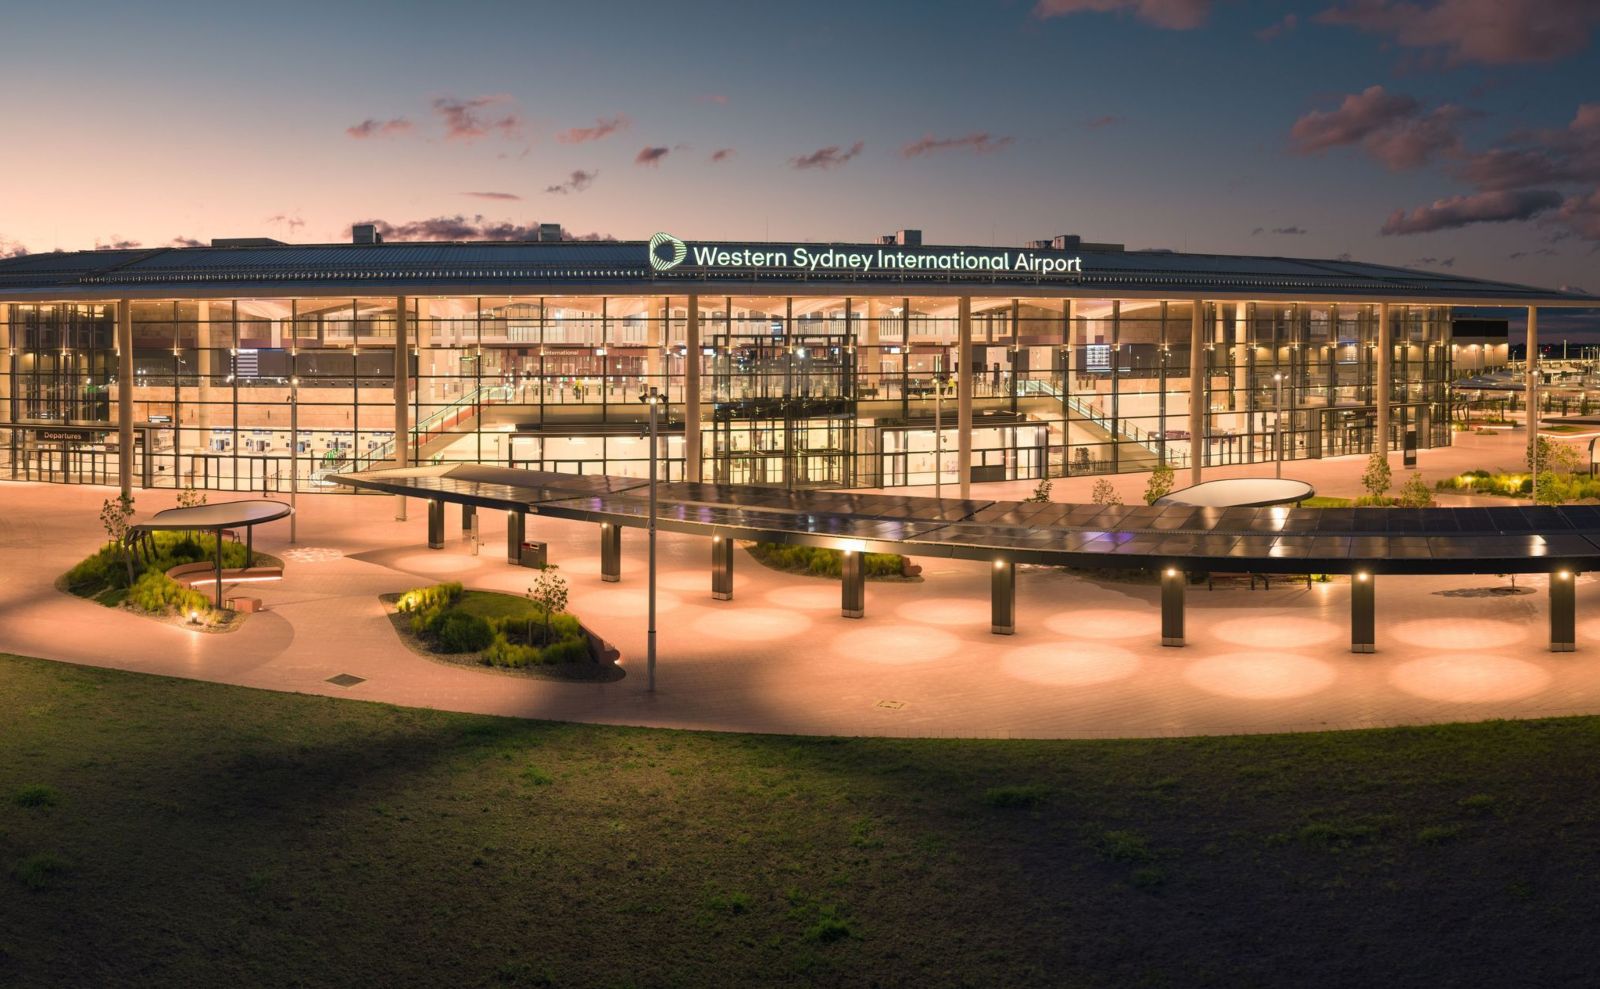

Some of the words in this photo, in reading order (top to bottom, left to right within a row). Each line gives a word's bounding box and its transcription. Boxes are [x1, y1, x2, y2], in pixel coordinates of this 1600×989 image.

[693, 246, 787, 267] Western
[793, 247, 873, 272] Sydney
[878, 249, 1010, 270] International
[1014, 252, 1082, 275] Airport
[44, 431, 82, 440] Departures
